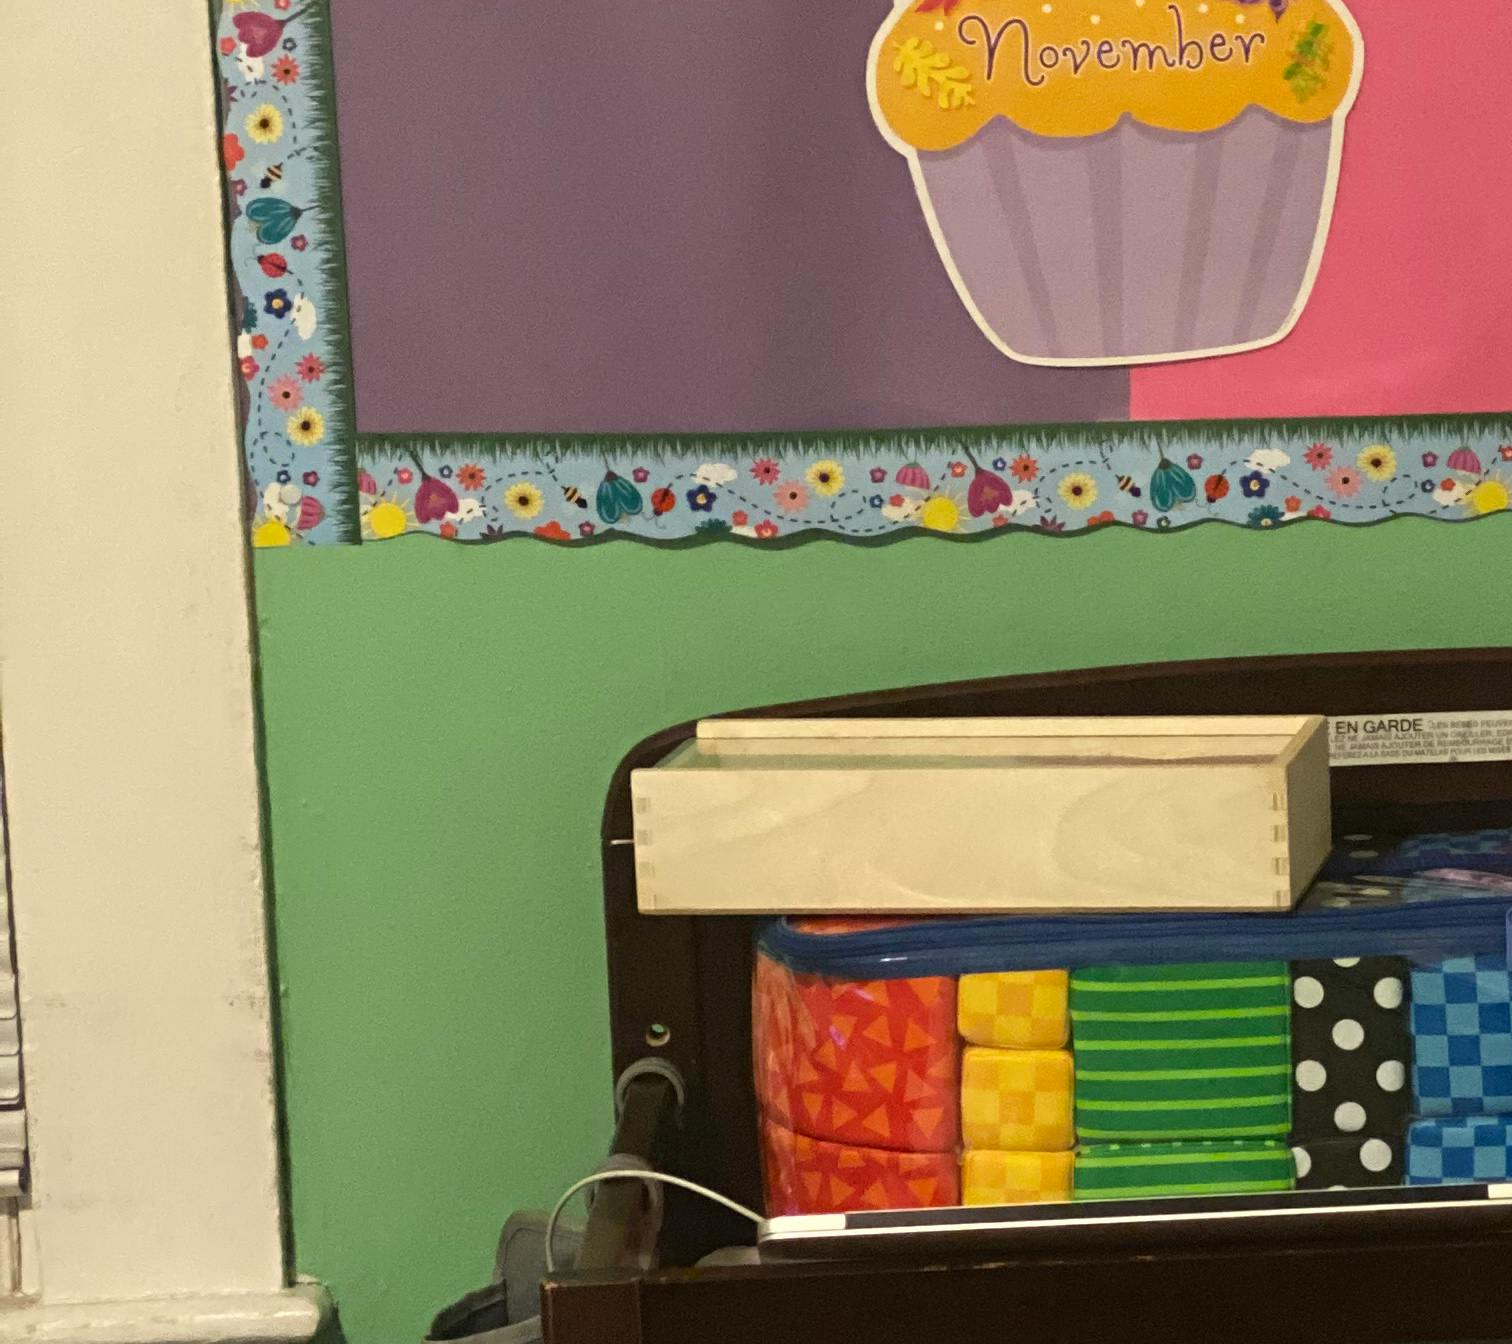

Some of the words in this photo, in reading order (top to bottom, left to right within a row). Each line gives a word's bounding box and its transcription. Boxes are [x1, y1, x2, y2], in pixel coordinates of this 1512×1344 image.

[957, 4, 1266, 87] November
[1335, 720, 1358, 735] EN
[1363, 718, 1424, 734] GARDE
